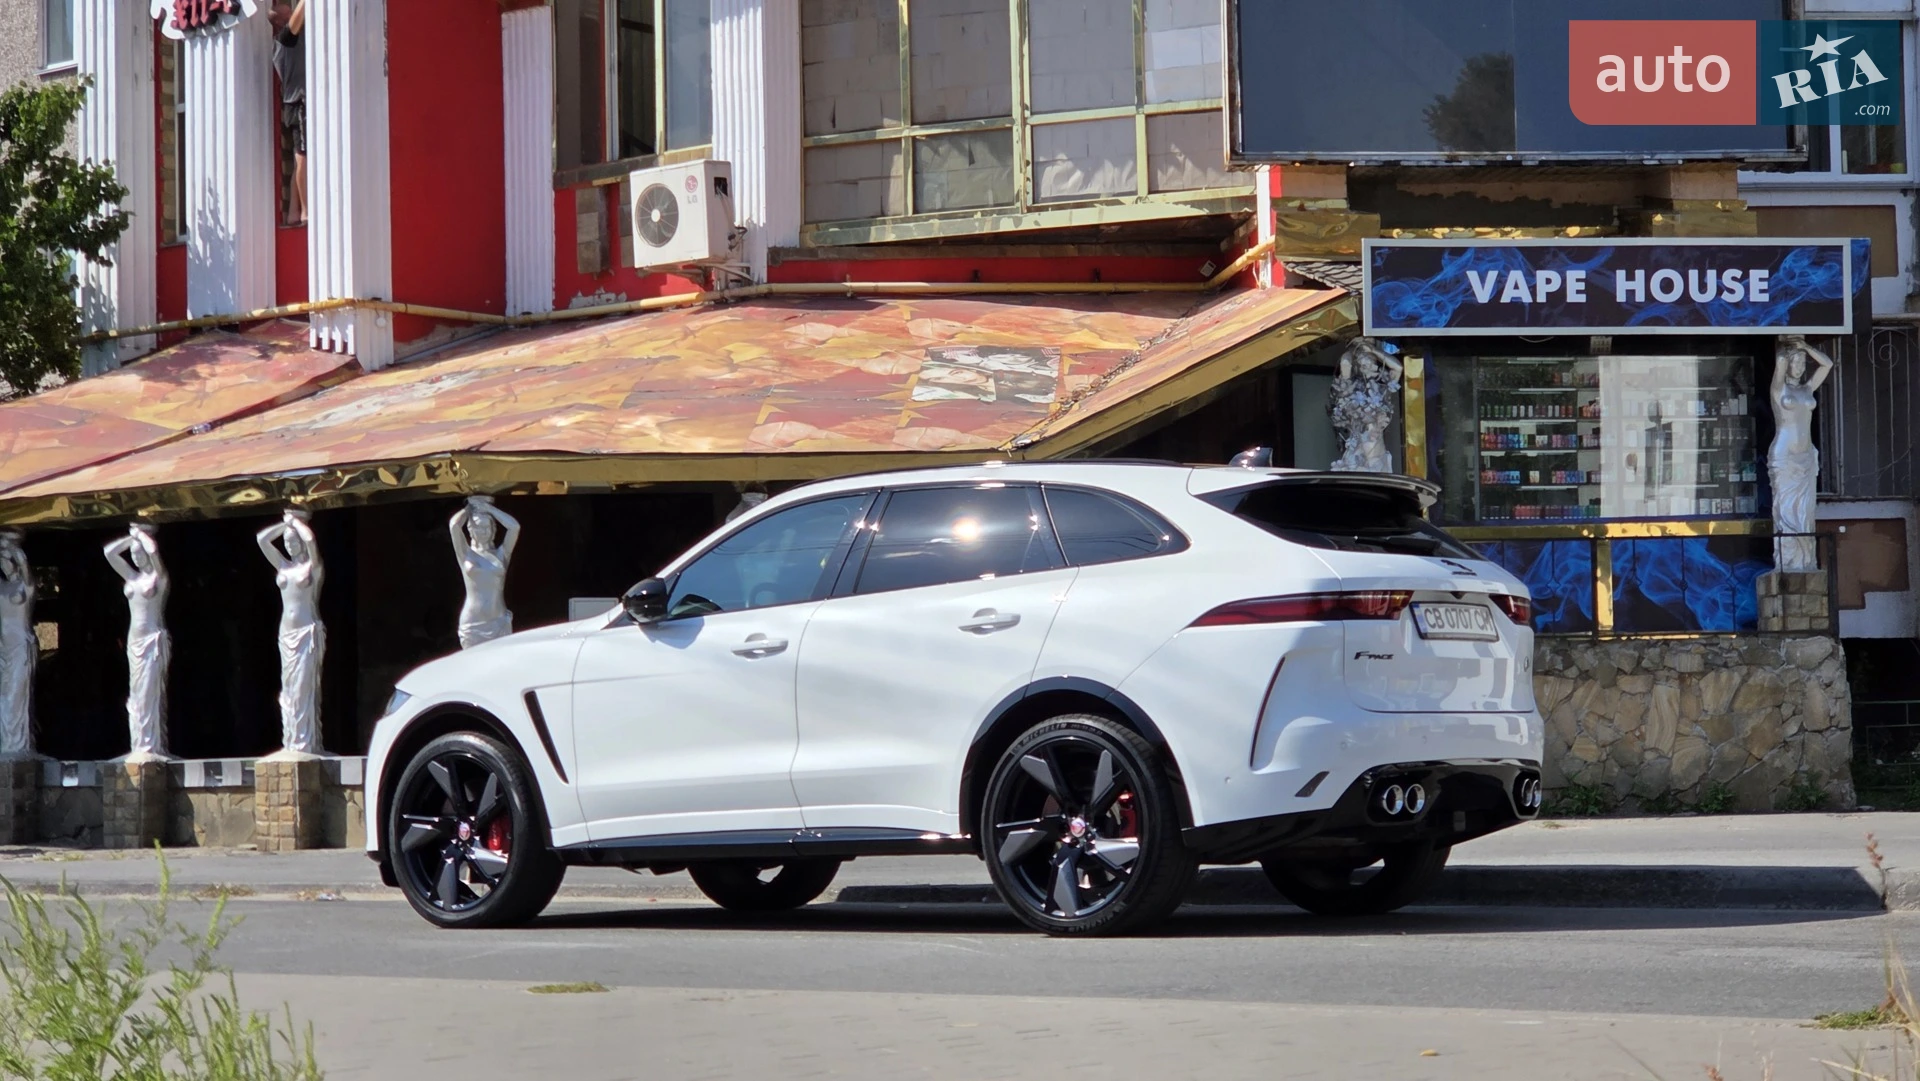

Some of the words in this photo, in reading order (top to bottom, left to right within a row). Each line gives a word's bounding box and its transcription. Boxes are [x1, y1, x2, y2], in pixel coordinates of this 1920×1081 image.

[1466, 269, 1587, 303] VAPE
[1615, 268, 1771, 303] HOUSE
[1424, 607, 1445, 629] CB
[1445, 607, 1473, 629] 0707
